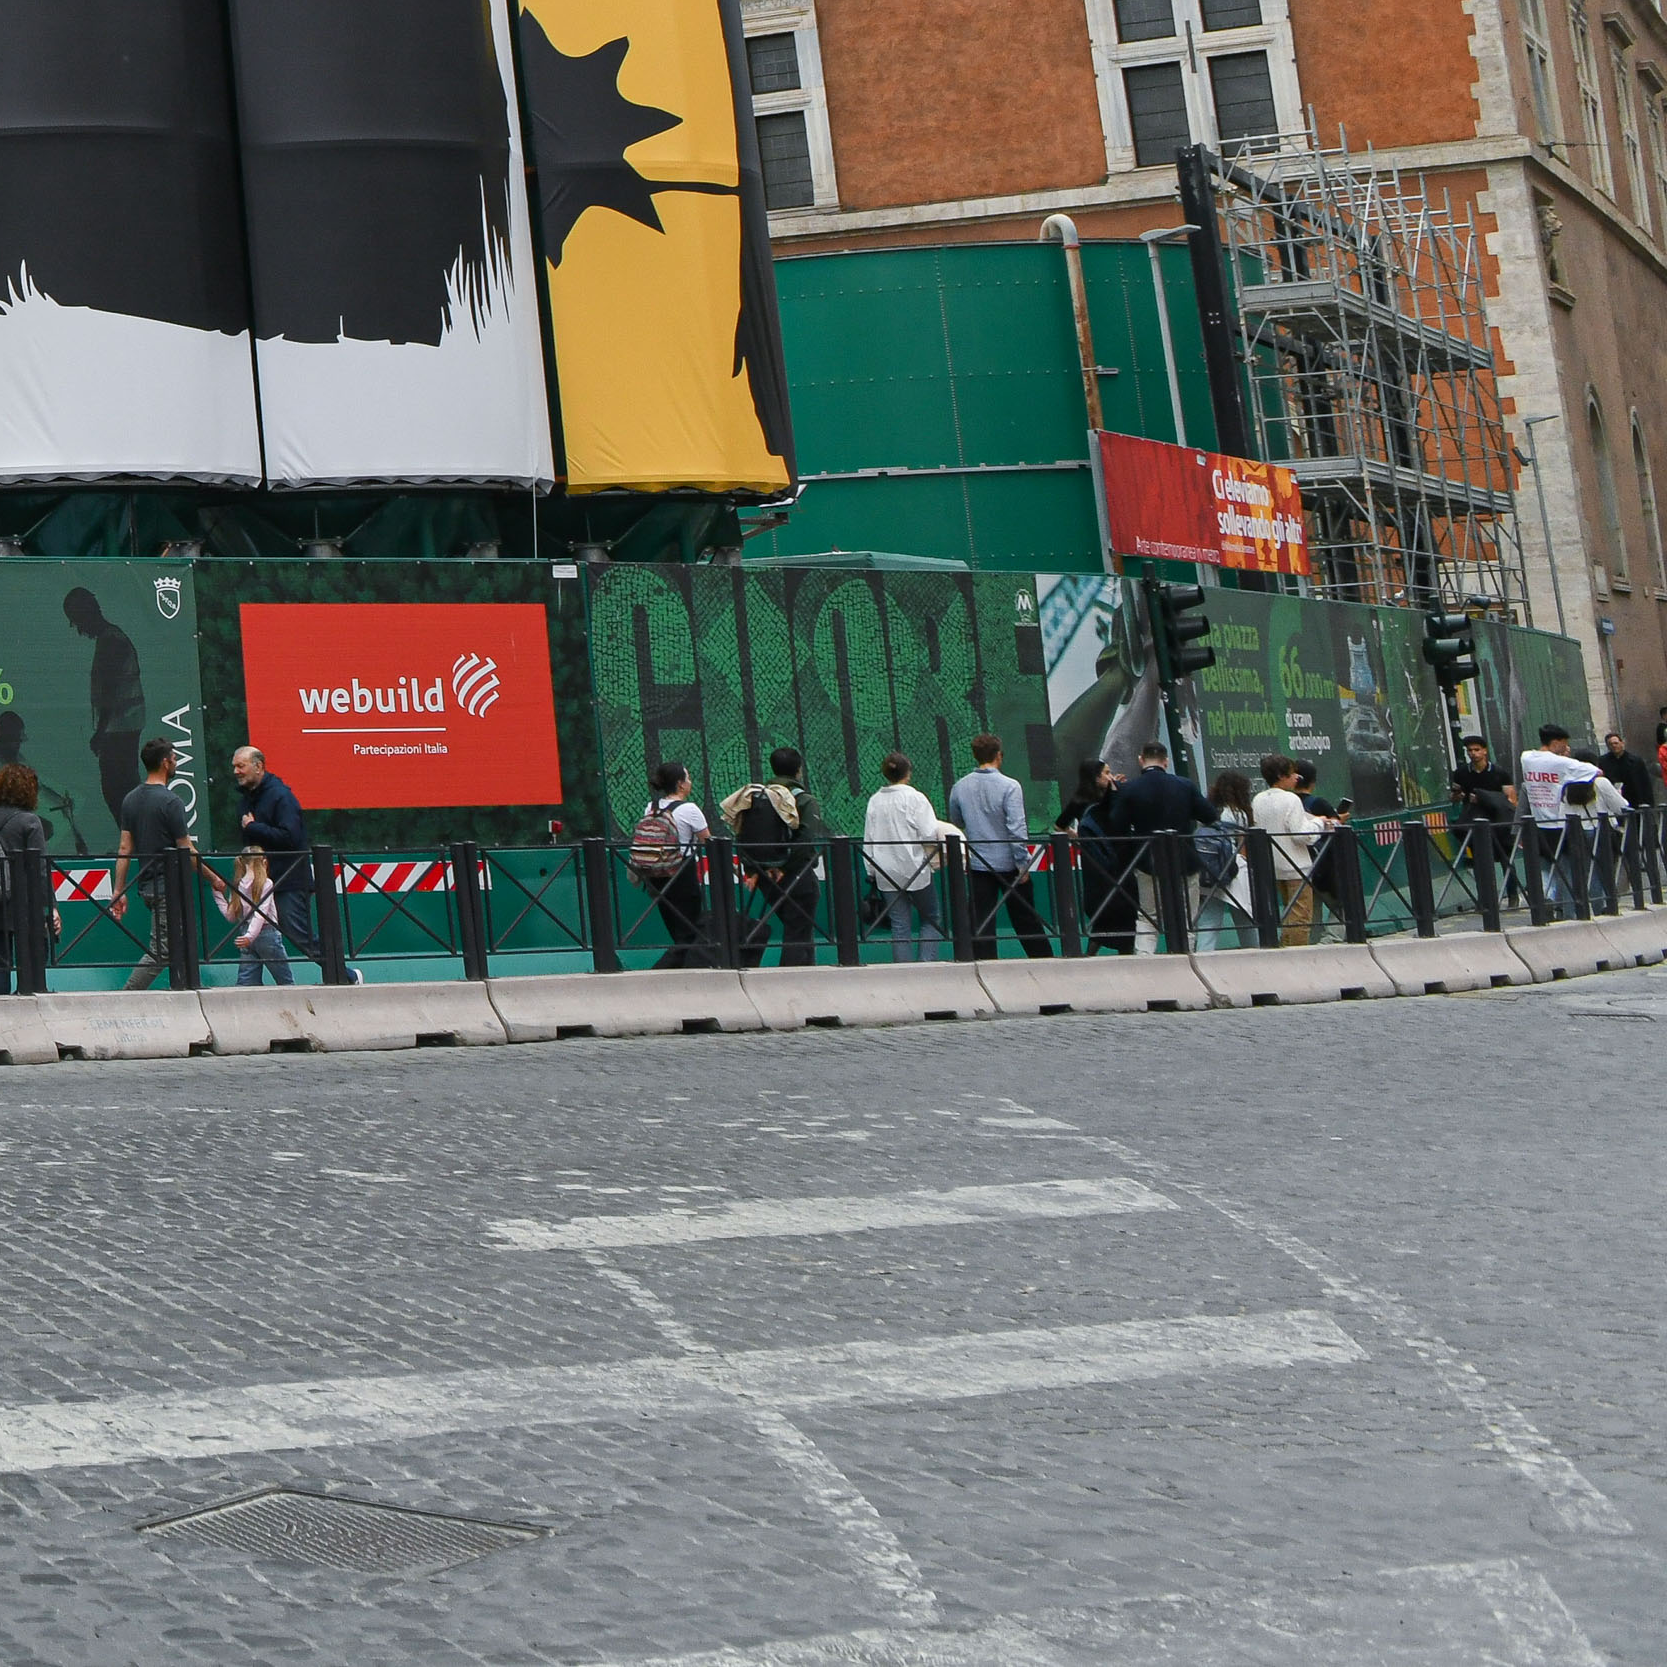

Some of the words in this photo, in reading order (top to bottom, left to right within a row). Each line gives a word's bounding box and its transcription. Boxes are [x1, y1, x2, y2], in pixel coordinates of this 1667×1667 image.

[1212, 469, 1224, 499] Ci
[1224, 472, 1271, 507] eleviamo
[1218, 504, 1271, 540] sollevando
[1272, 511, 1285, 550] gli
[1285, 514, 1303, 545] altri
[1222, 615, 1260, 659] piazza
[299, 676, 445, 714] webuild
[1207, 701, 1225, 736] nel
[1228, 700, 1277, 745] profondo
[1286, 707, 1293, 728] di
[1294, 711, 1313, 728] scavo
[353, 743, 422, 757] Partecipazioni
[425, 742, 448, 754] Italia
[1211, 747, 1239, 768] Stazione
[1288, 731, 1331, 755] archeologico
[161, 703, 198, 842] OMA
